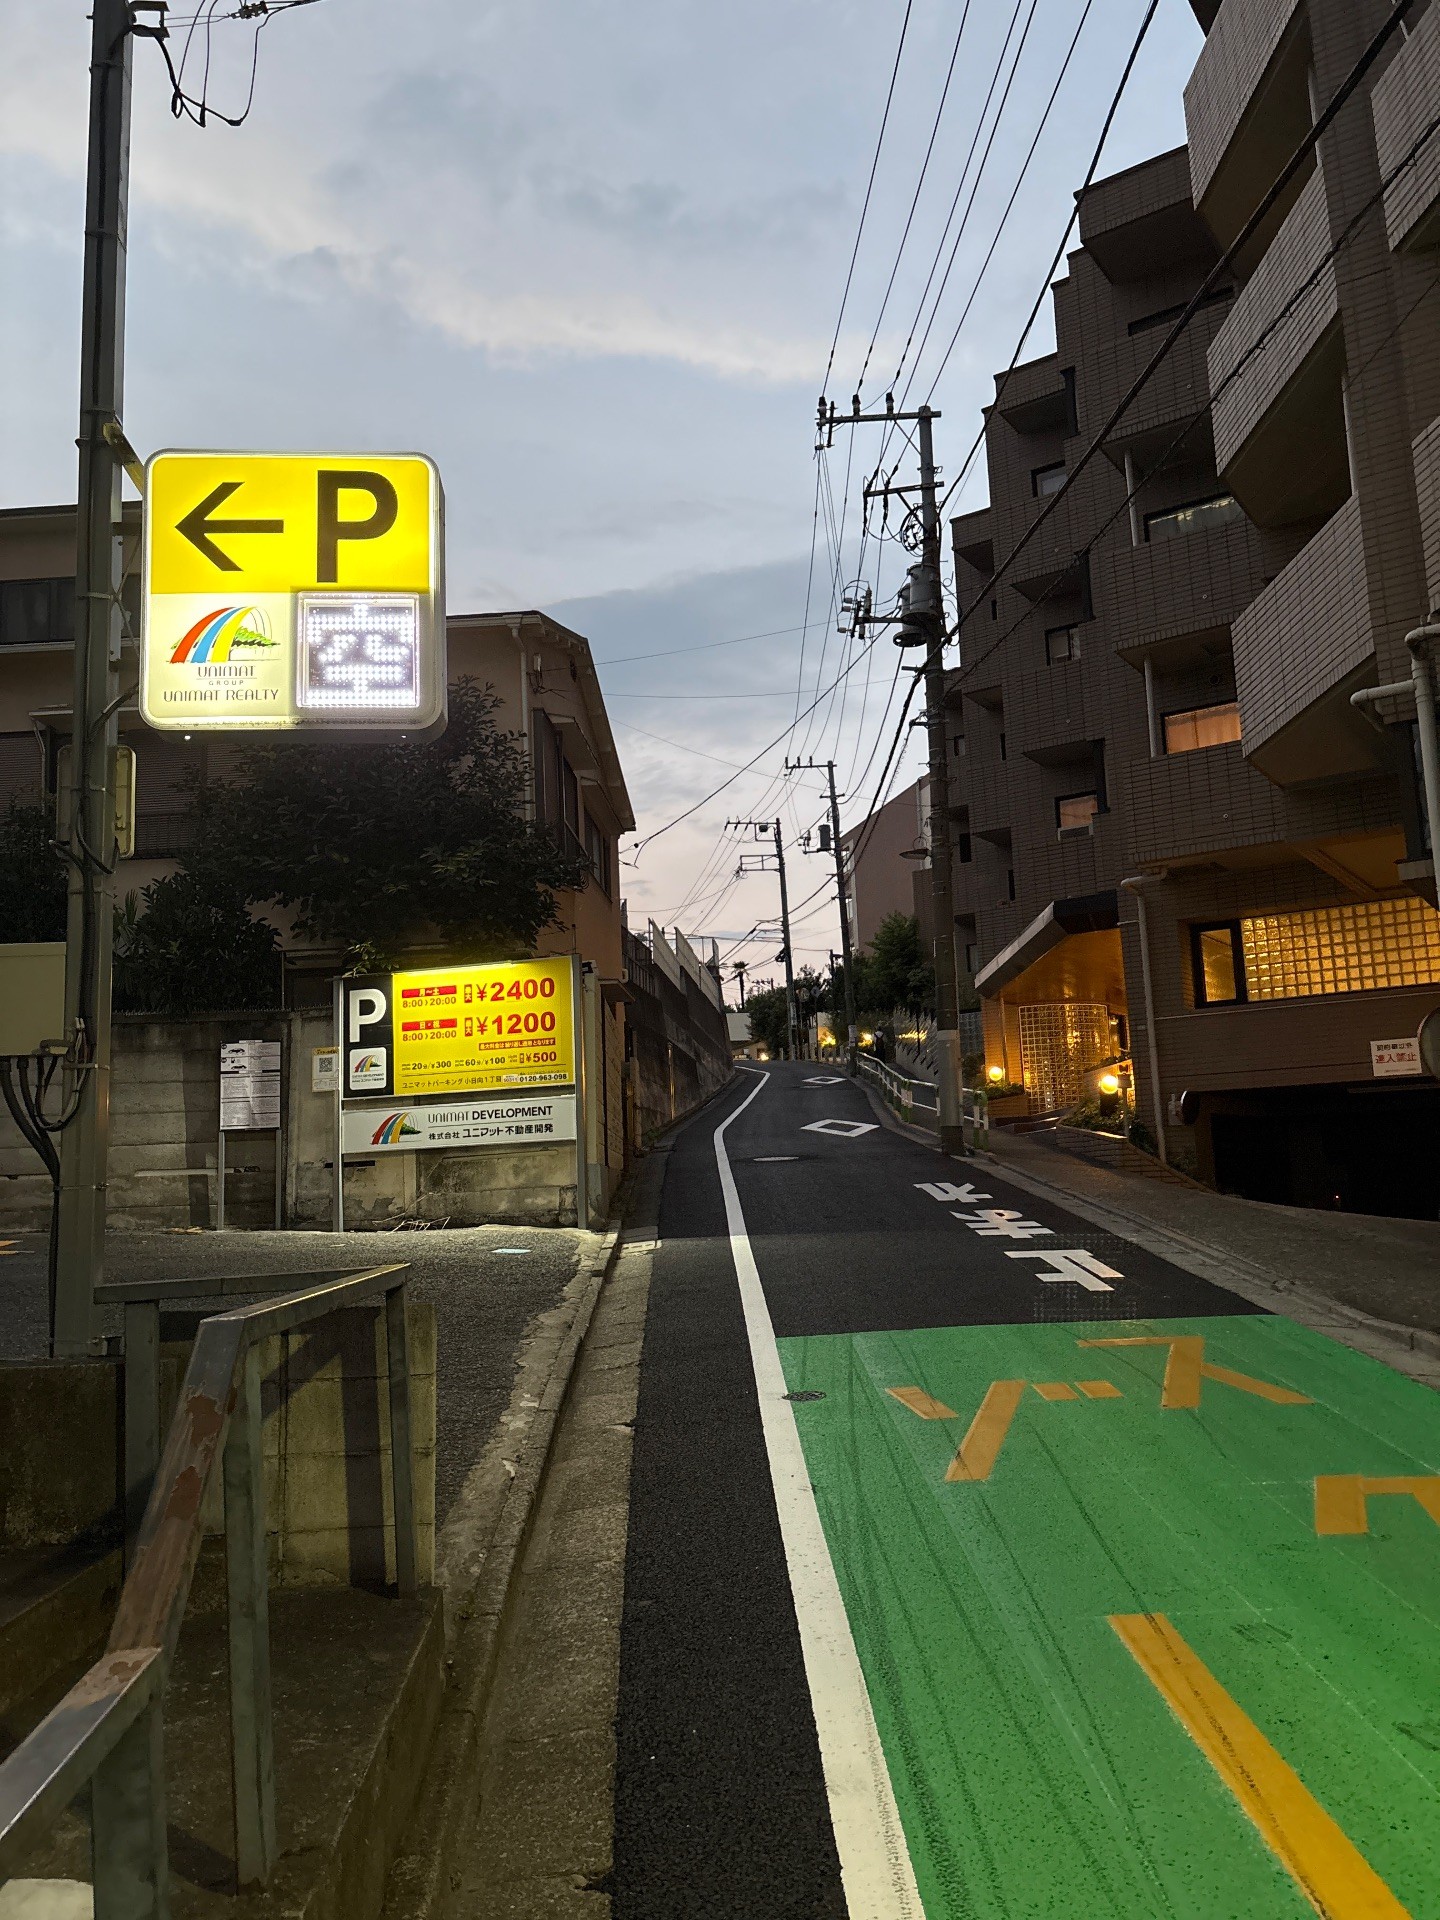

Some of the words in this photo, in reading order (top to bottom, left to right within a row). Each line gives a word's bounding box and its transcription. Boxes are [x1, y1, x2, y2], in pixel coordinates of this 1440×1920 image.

[317, 470, 398, 583] P
[198, 665, 255, 677] UNIMAT
[164, 690, 220, 702] UNIMAT
[226, 689, 279, 701] REALTY
[349, 988, 386, 1043] P
[1375, 1052, 1417, 1064] 進入禁止
[428, 1110, 469, 1123] UNIMAT
[472, 1105, 554, 1121] DEVELOPMENT
